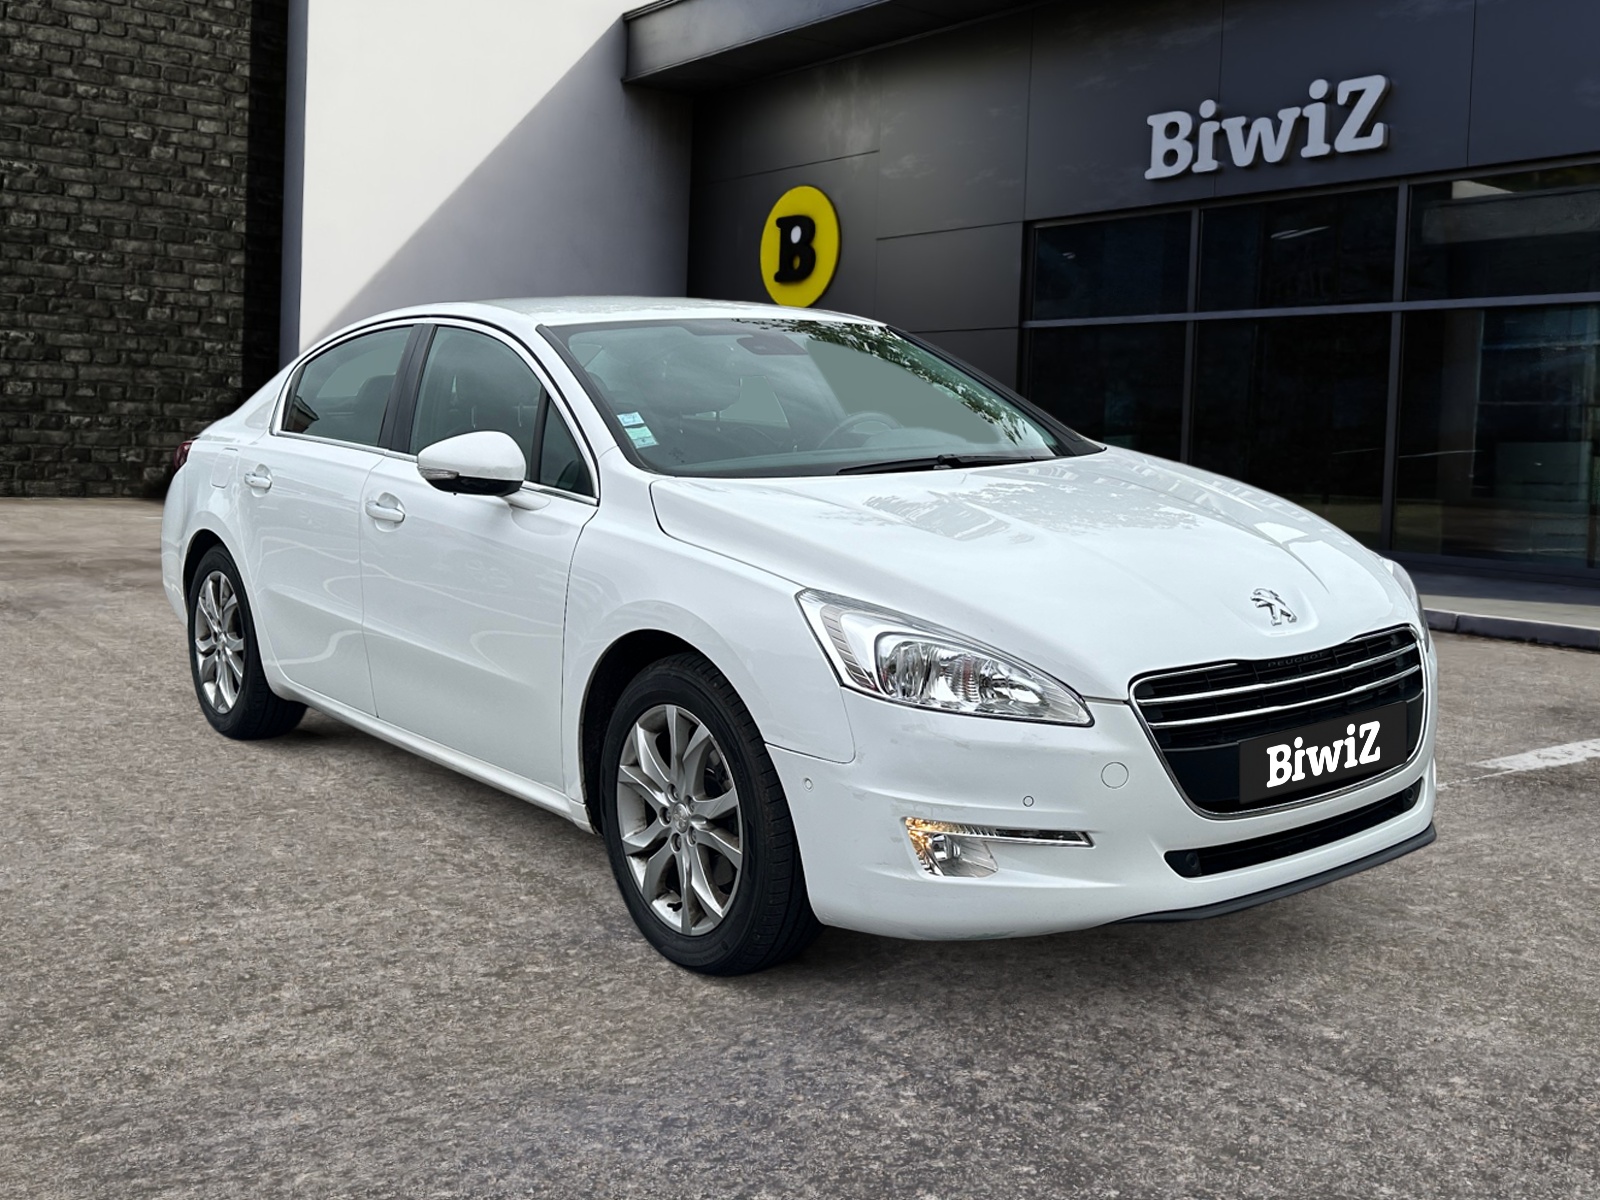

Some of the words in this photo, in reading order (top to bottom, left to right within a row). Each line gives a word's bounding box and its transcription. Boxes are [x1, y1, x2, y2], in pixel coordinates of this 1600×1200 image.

[1144, 74, 1388, 180] BiwiZ
[774, 215, 816, 284] B
[1267, 652, 1325, 668] PEUGEOT
[1266, 721, 1381, 788] BiwiZ
